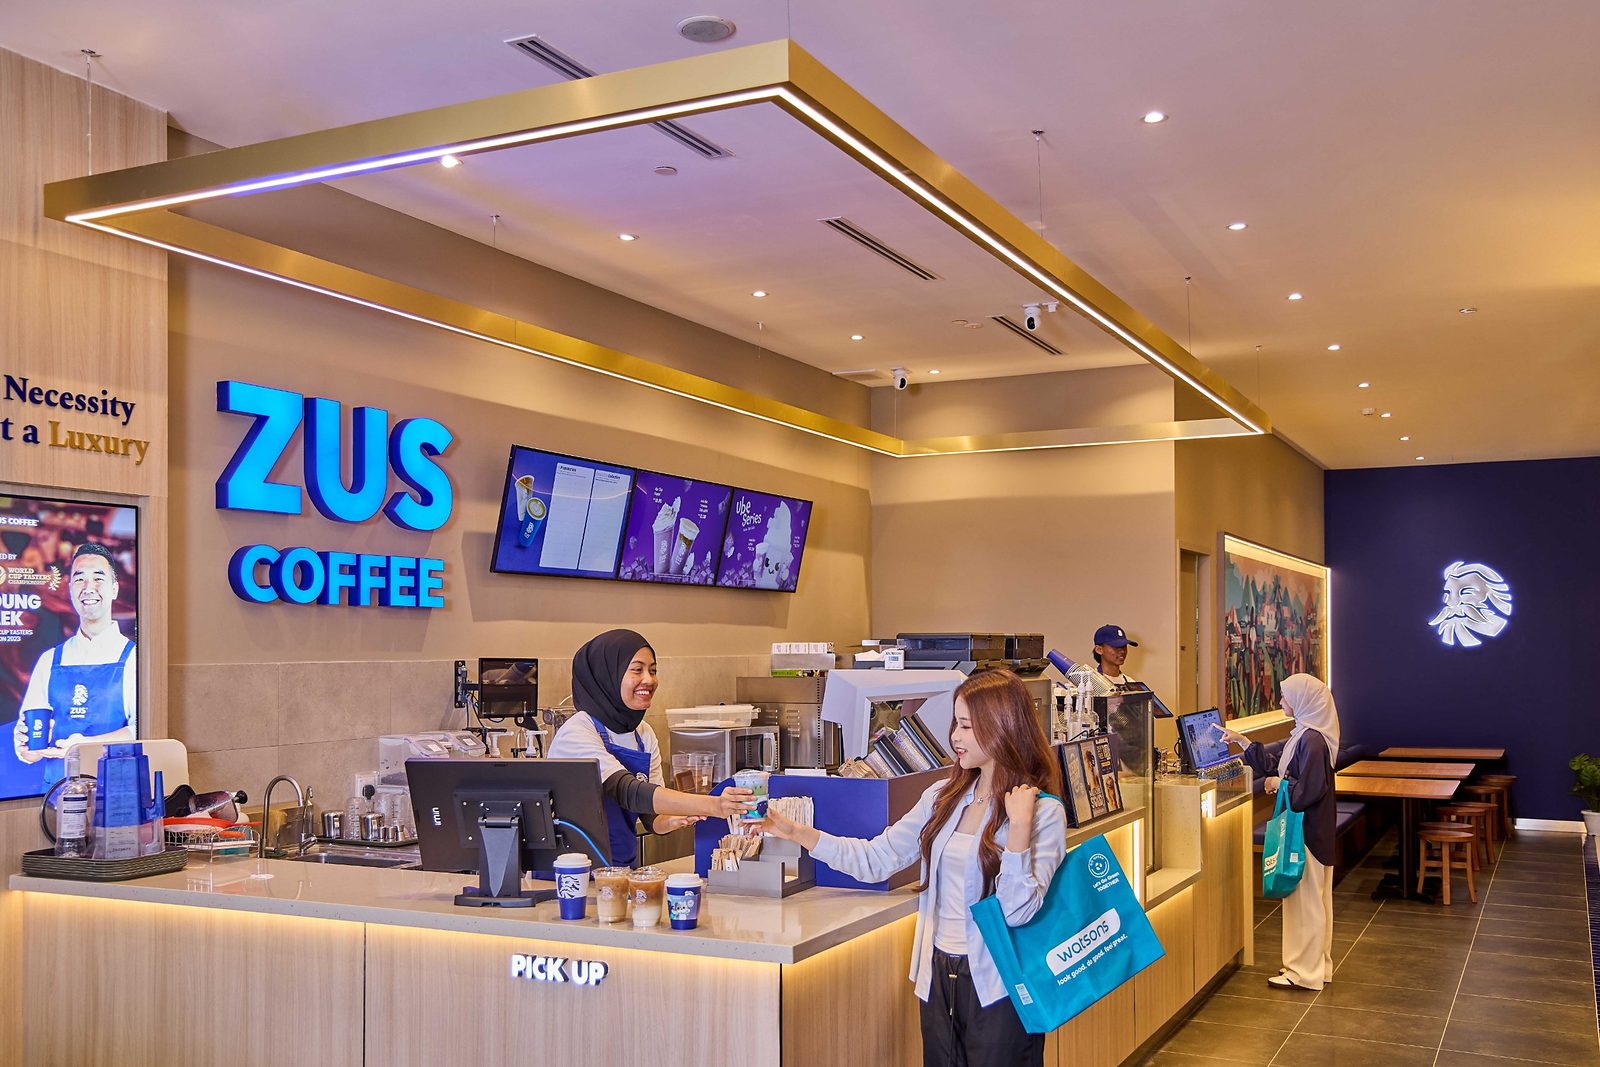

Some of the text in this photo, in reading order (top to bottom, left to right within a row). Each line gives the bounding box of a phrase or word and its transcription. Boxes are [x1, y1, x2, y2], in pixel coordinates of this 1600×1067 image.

[4, 374, 136, 426] Necessity
[22, 424, 40, 445] a
[48, 420, 150, 465] Luxury
[216, 380, 454, 531] ZUS
[8, 518, 38, 527] COFFEE
[741, 513, 762, 527] Series
[228, 543, 445, 608] COFFEE
[0, 593, 42, 610] UNG
[0, 610, 24, 626] EK
[1056, 920, 1110, 962] watsons
[511, 953, 609, 987] PICK UP
[1056, 973, 1072, 986] look
[1086, 958, 1094, 967] do
